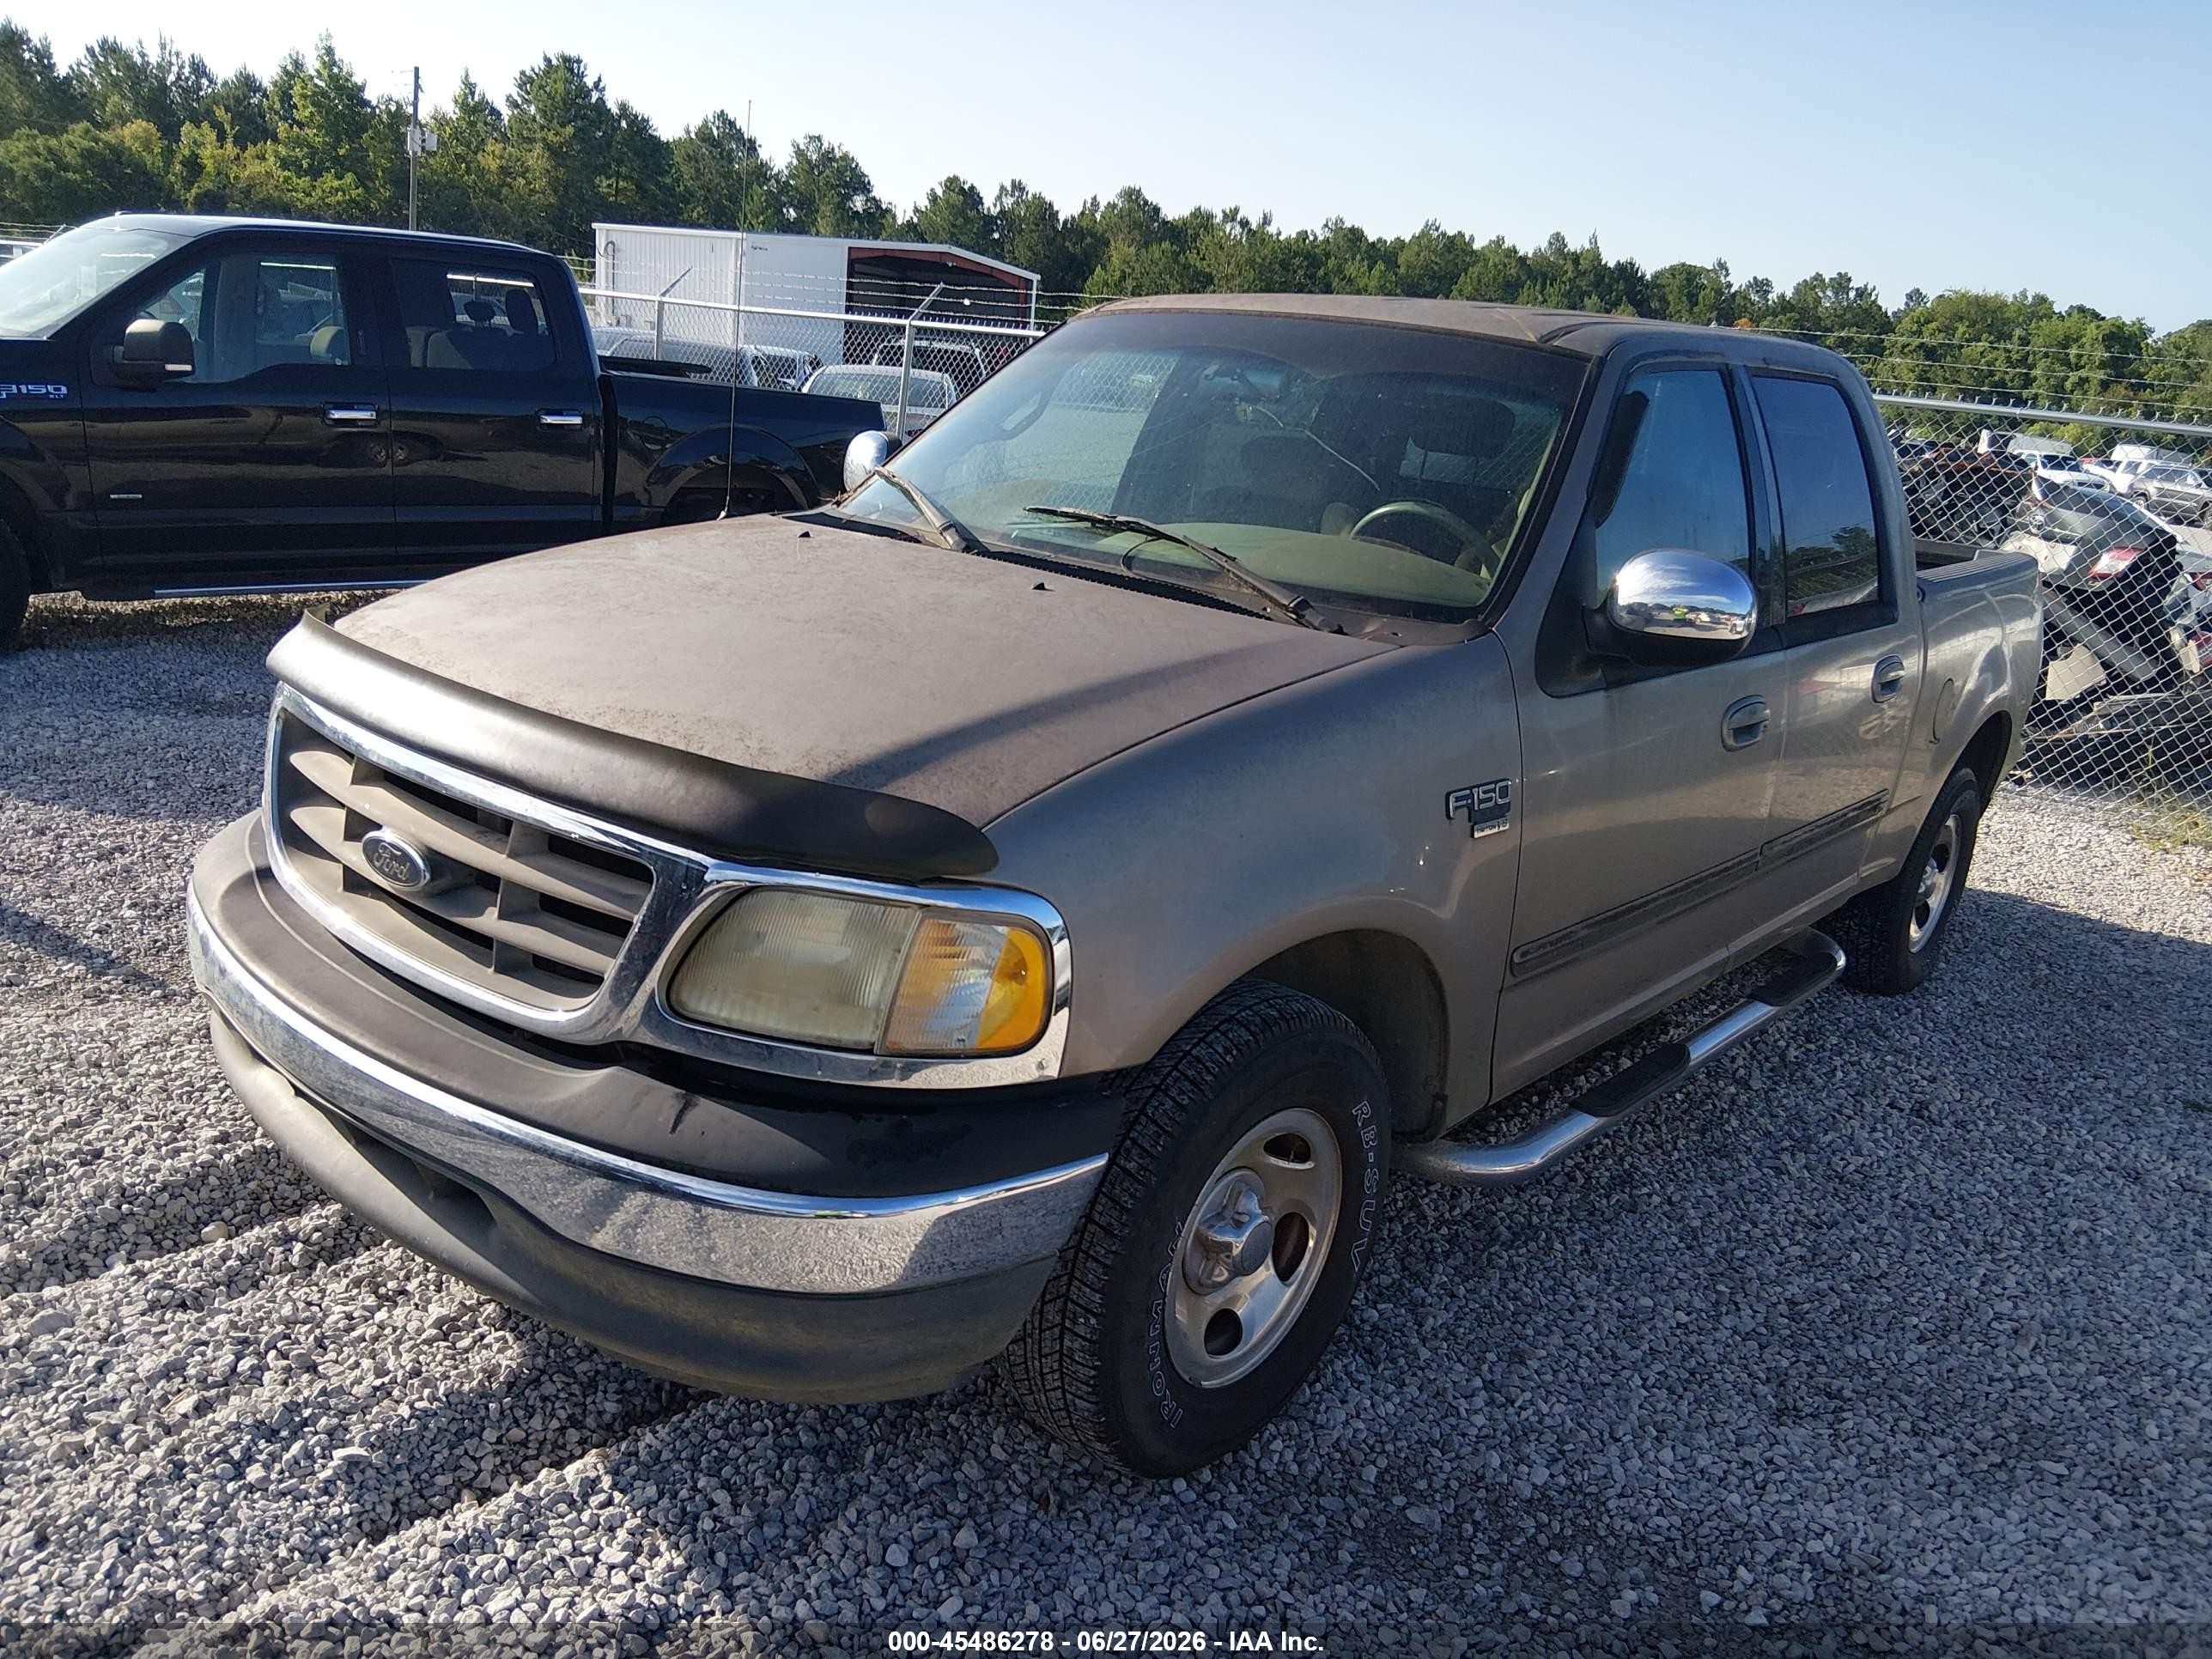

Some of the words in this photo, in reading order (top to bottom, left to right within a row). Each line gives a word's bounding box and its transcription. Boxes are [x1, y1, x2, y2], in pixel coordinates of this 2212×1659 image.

[1449, 780, 1512, 818] F-150
[373, 842, 411, 881] Ford
[1351, 1100, 1379, 1272] RB-SUV
